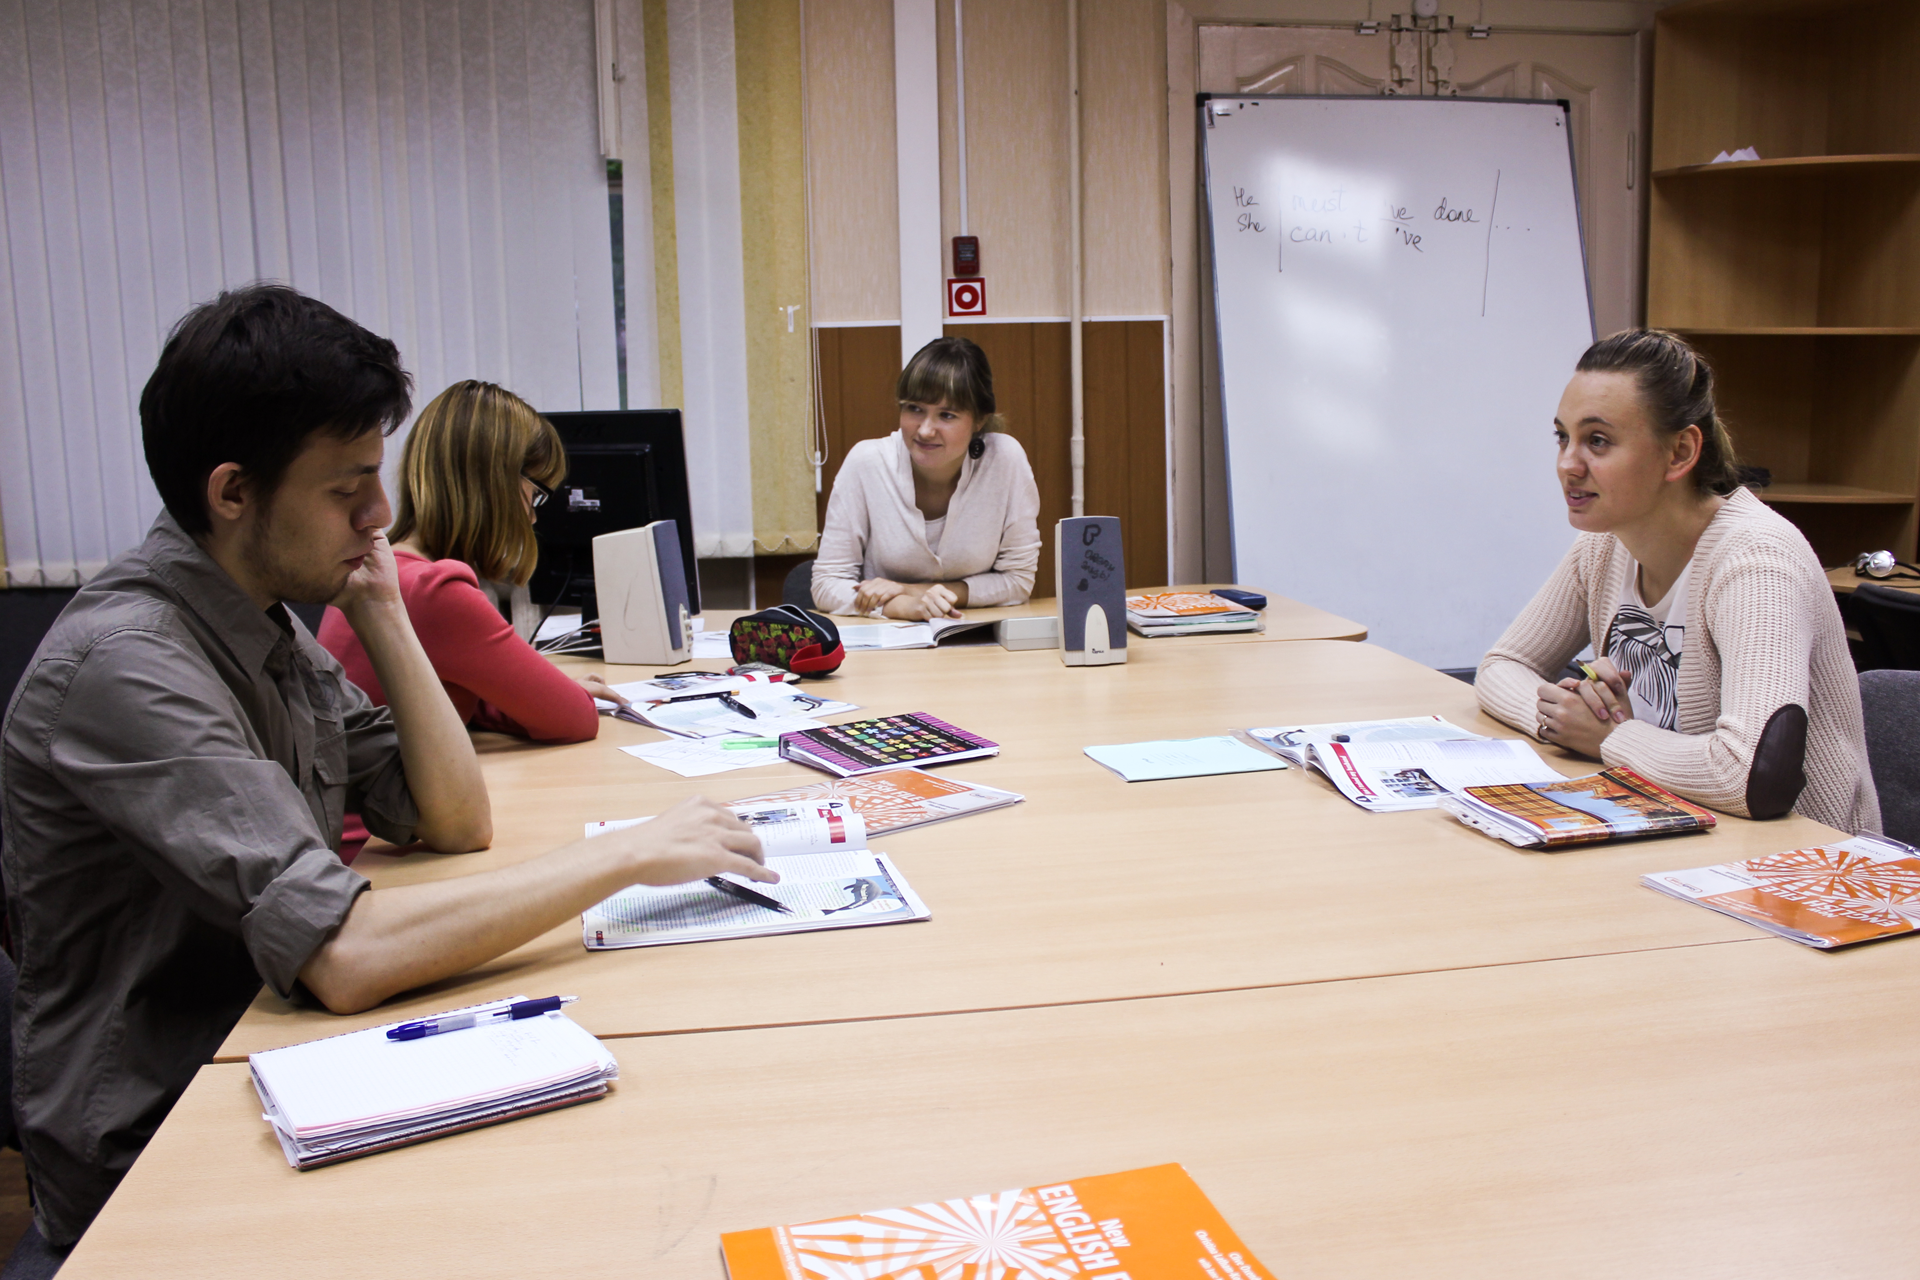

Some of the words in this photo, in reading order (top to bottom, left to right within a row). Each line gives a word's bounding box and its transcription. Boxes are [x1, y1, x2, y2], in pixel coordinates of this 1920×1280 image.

[1233, 186, 1260, 208] He
[1291, 183, 1348, 213] must
[1434, 196, 1480, 223] done
[1237, 212, 1267, 233] She
[890, 790, 926, 802] FILE
[1758, 884, 1808, 902] FILE
[1801, 899, 1902, 928] ENGLISH
[1805, 907, 1839, 918] New
[1037, 1184, 1120, 1271] ENGLISH
[1097, 1218, 1131, 1248] New
[1195, 1230, 1219, 1255] Christina
